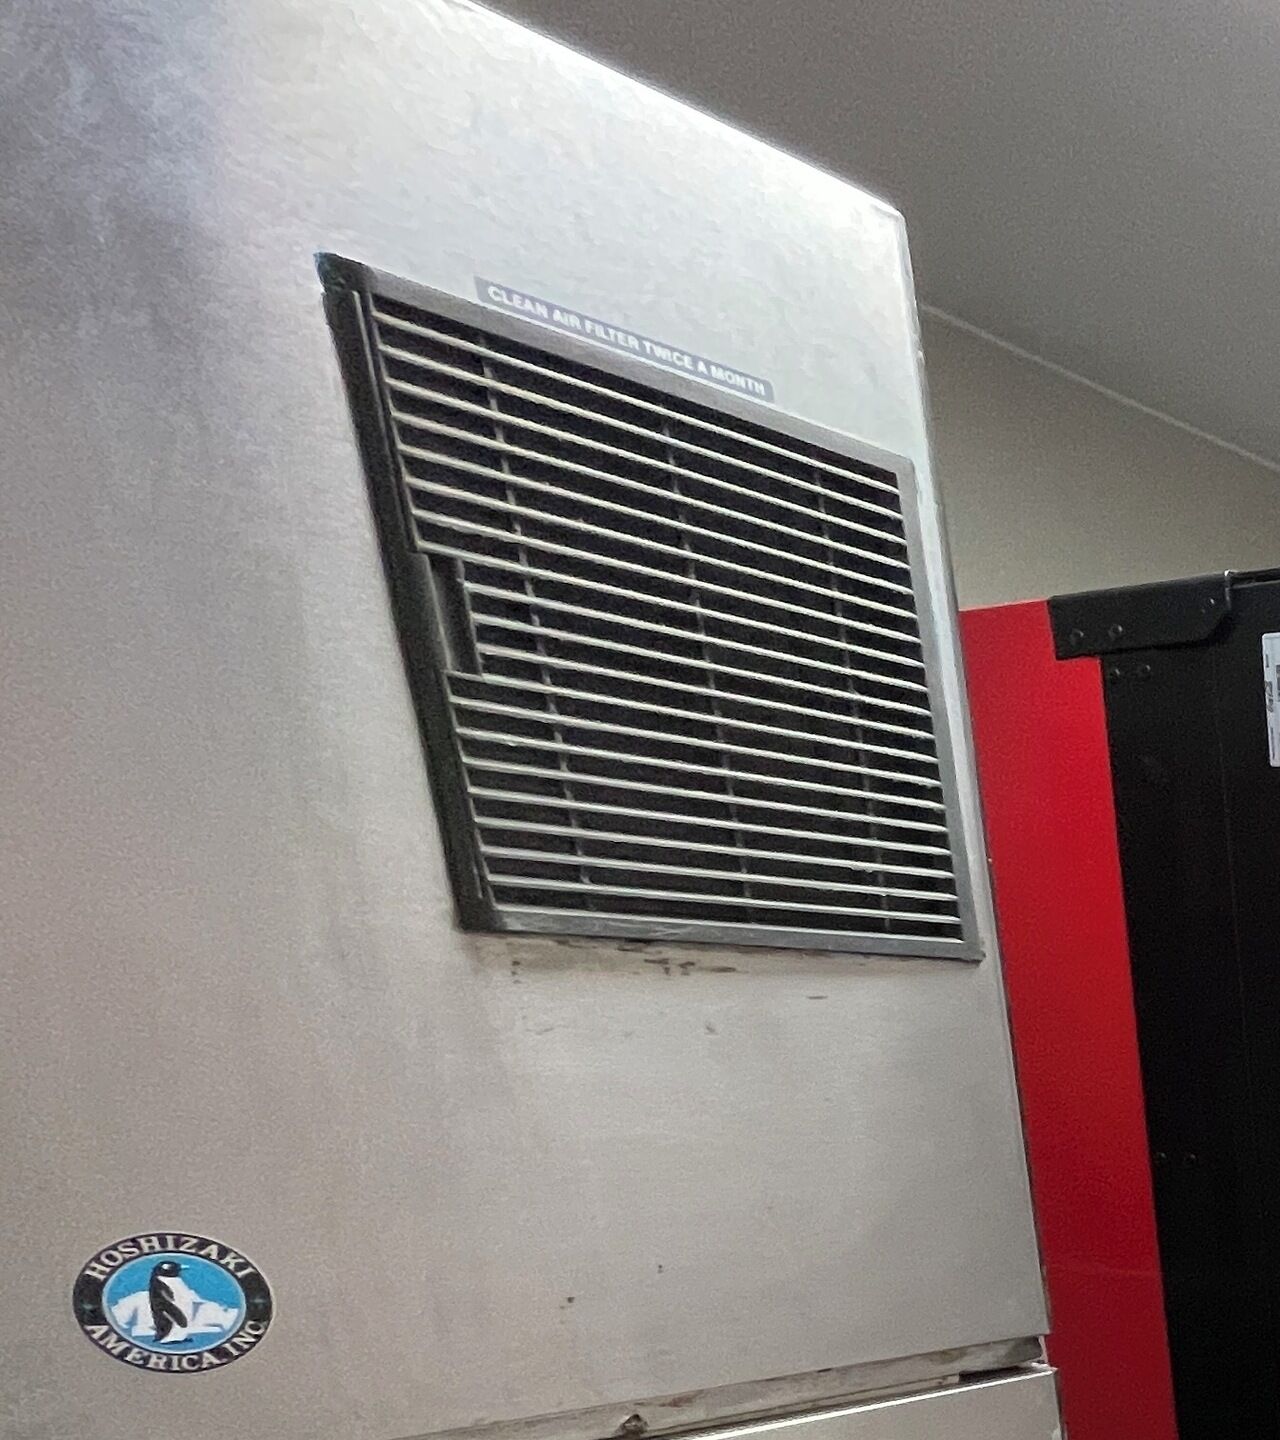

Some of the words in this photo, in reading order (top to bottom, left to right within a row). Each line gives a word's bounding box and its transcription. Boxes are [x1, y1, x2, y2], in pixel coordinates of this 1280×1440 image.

[488, 285, 549, 318] CLEAN
[552, 308, 582, 330] AIR
[585, 319, 640, 350] FILTER
[642, 340, 693, 369] TWICE
[697, 361, 708, 376] A
[711, 366, 766, 396] MONTH
[84, 1235, 256, 1281] HOSHIZAKI
